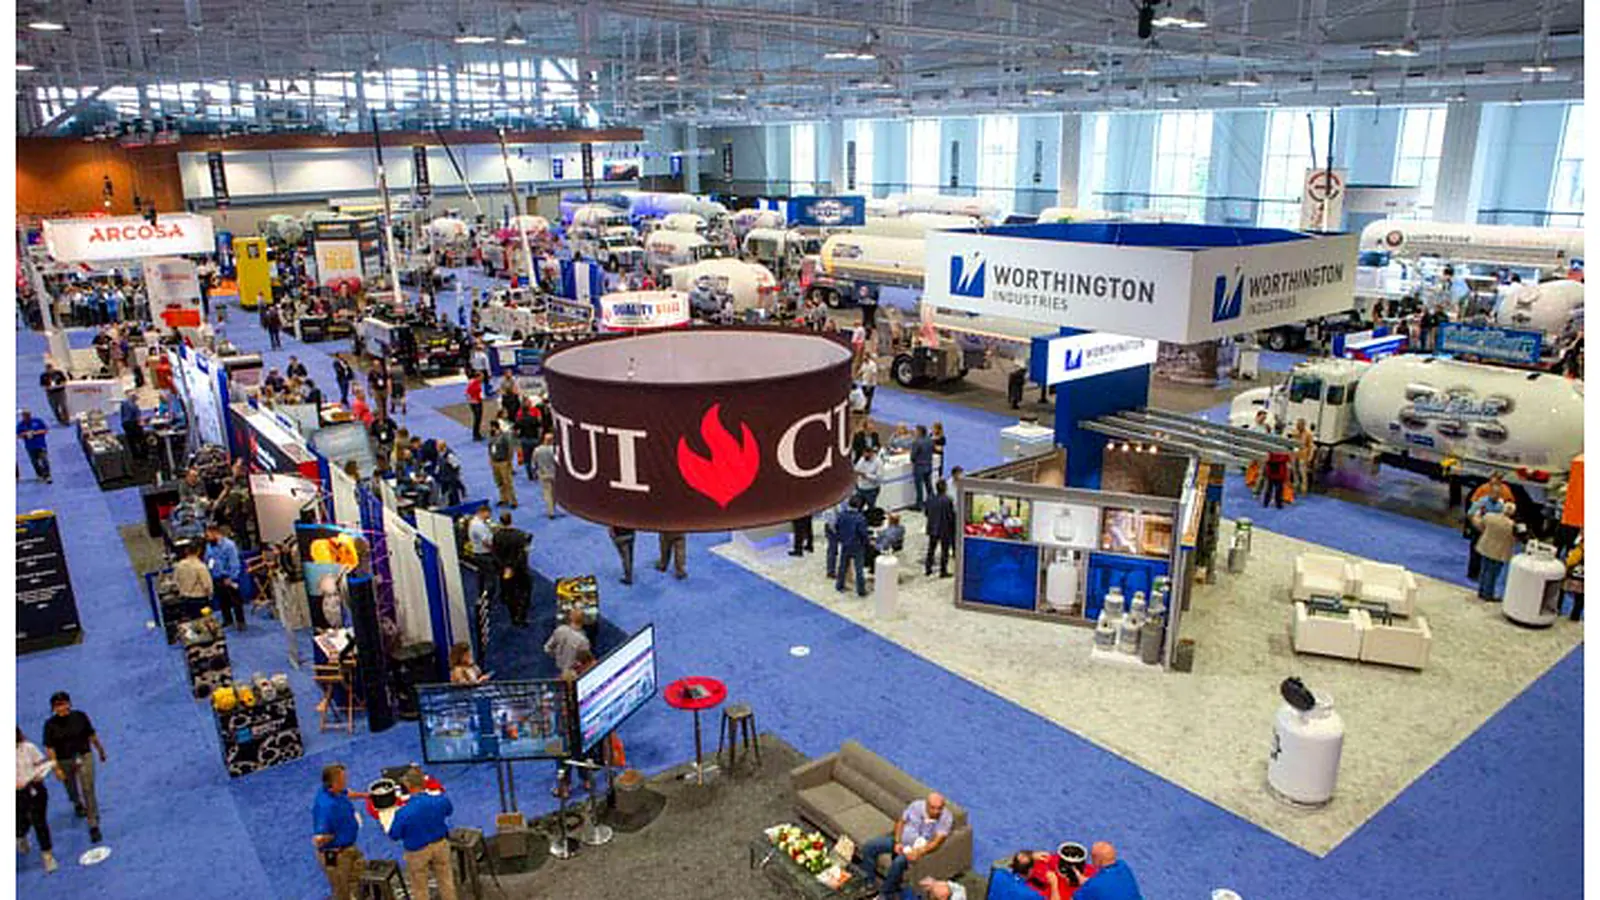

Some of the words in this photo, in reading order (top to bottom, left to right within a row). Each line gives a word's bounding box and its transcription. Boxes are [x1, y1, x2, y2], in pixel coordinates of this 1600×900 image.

[88, 223, 185, 243] ARCOSA
[993, 265, 1156, 304] WORTHINGTON
[1248, 262, 1345, 298] WORTHINGTON
[991, 290, 1069, 311] INDUSTRIES
[549, 403, 650, 492] UI
